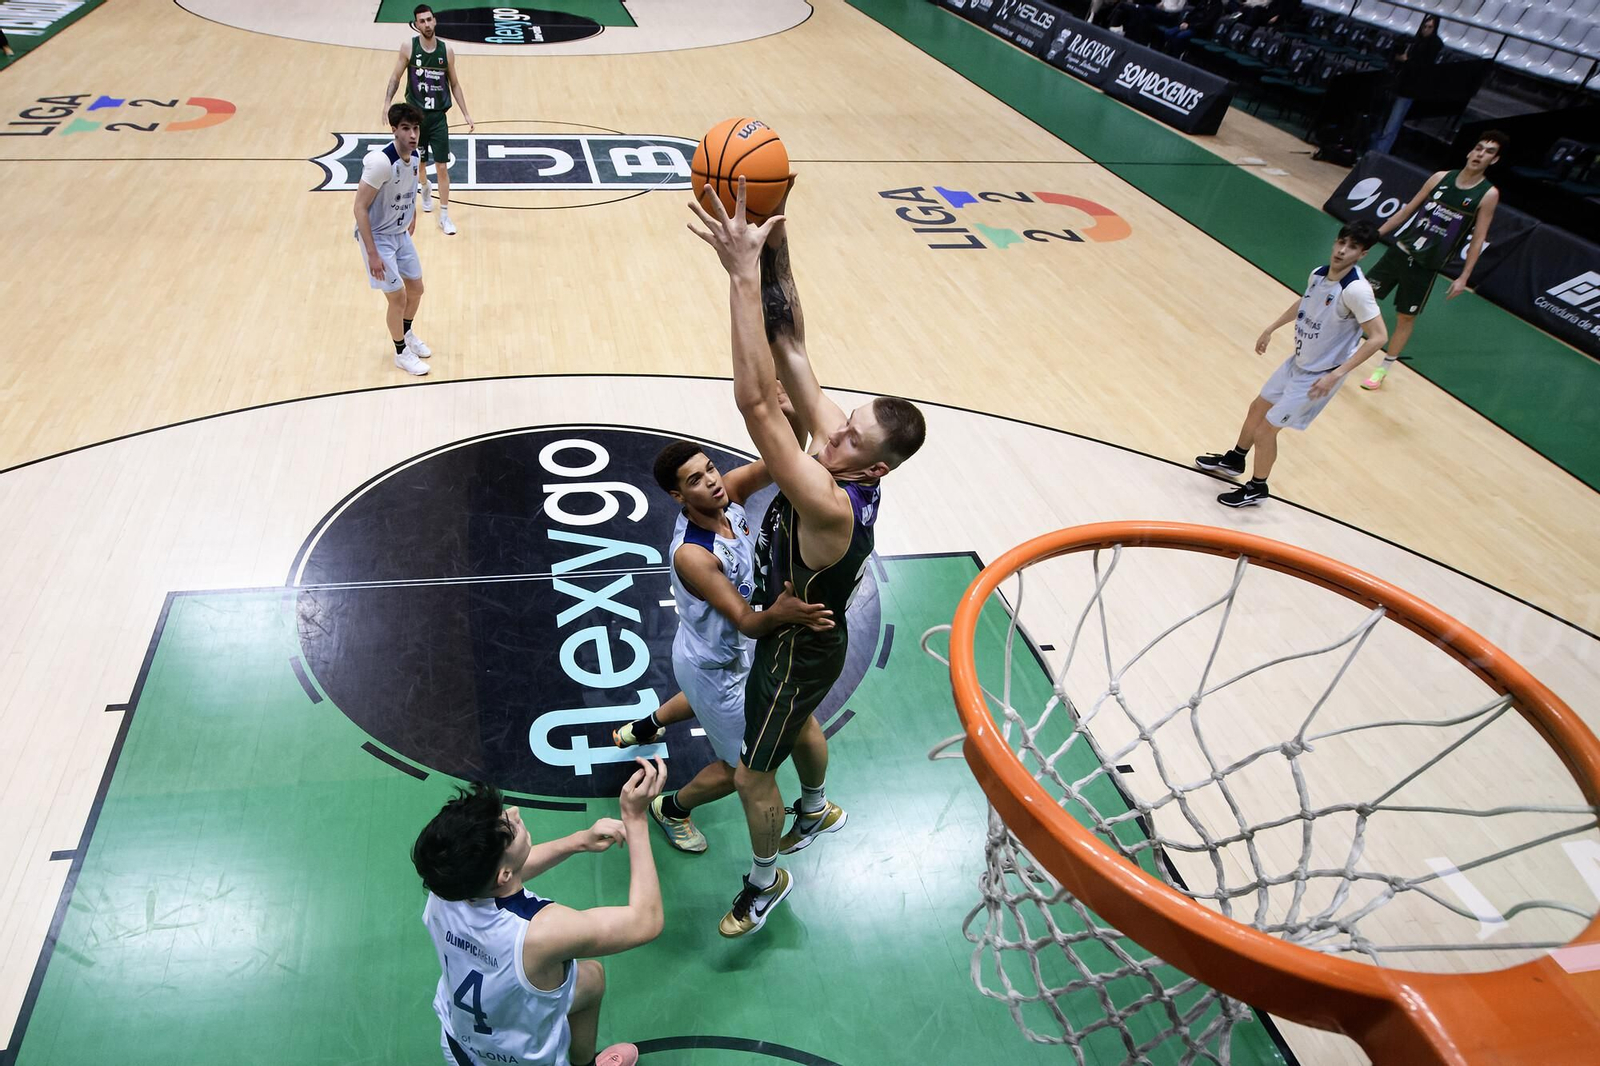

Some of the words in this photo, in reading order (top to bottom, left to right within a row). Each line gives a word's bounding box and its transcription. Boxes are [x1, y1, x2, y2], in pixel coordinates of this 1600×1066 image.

[485, 8, 532, 44] flexygo
[1067, 34, 1116, 68] RAGVSA
[424, 97, 435, 109] 21
[1118, 62, 1204, 112] SOMDOCENTS
[0, 93, 91, 136] LIGA
[877, 185, 987, 251] LIGA
[1534, 296, 1580, 326] Correduría
[1576, 319, 1592, 331] de
[529, 438, 669, 776] flexygo
